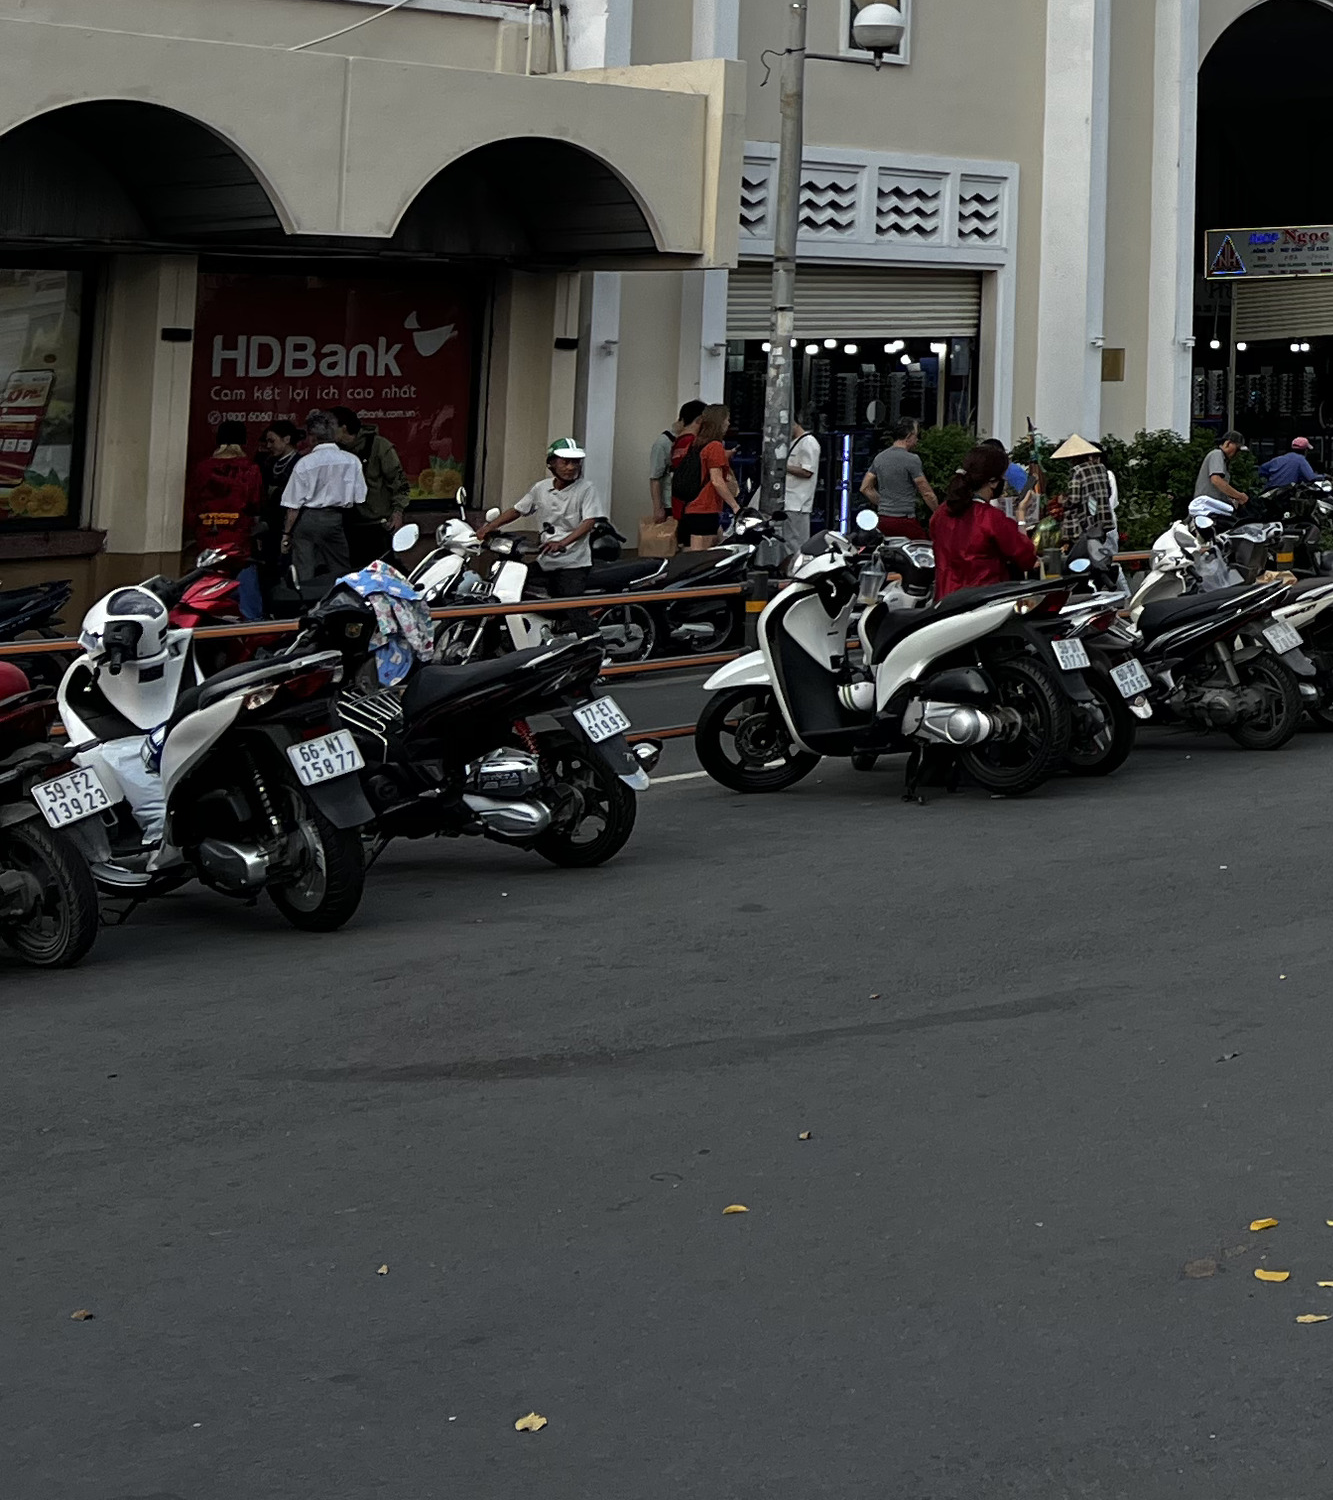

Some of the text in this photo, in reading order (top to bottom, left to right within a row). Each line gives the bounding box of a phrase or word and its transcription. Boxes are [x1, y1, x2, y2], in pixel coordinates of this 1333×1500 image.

[211, 334, 403, 377] HDBank
[210, 384, 417, 402] Cam kết lợi ích cao nhất
[588, 713, 627, 739] 619.93
[298, 735, 345, 763] 66-N1
[300, 750, 357, 782] 158.77
[44, 772, 94, 803] 59-F2
[48, 789, 108, 823] 139.23
